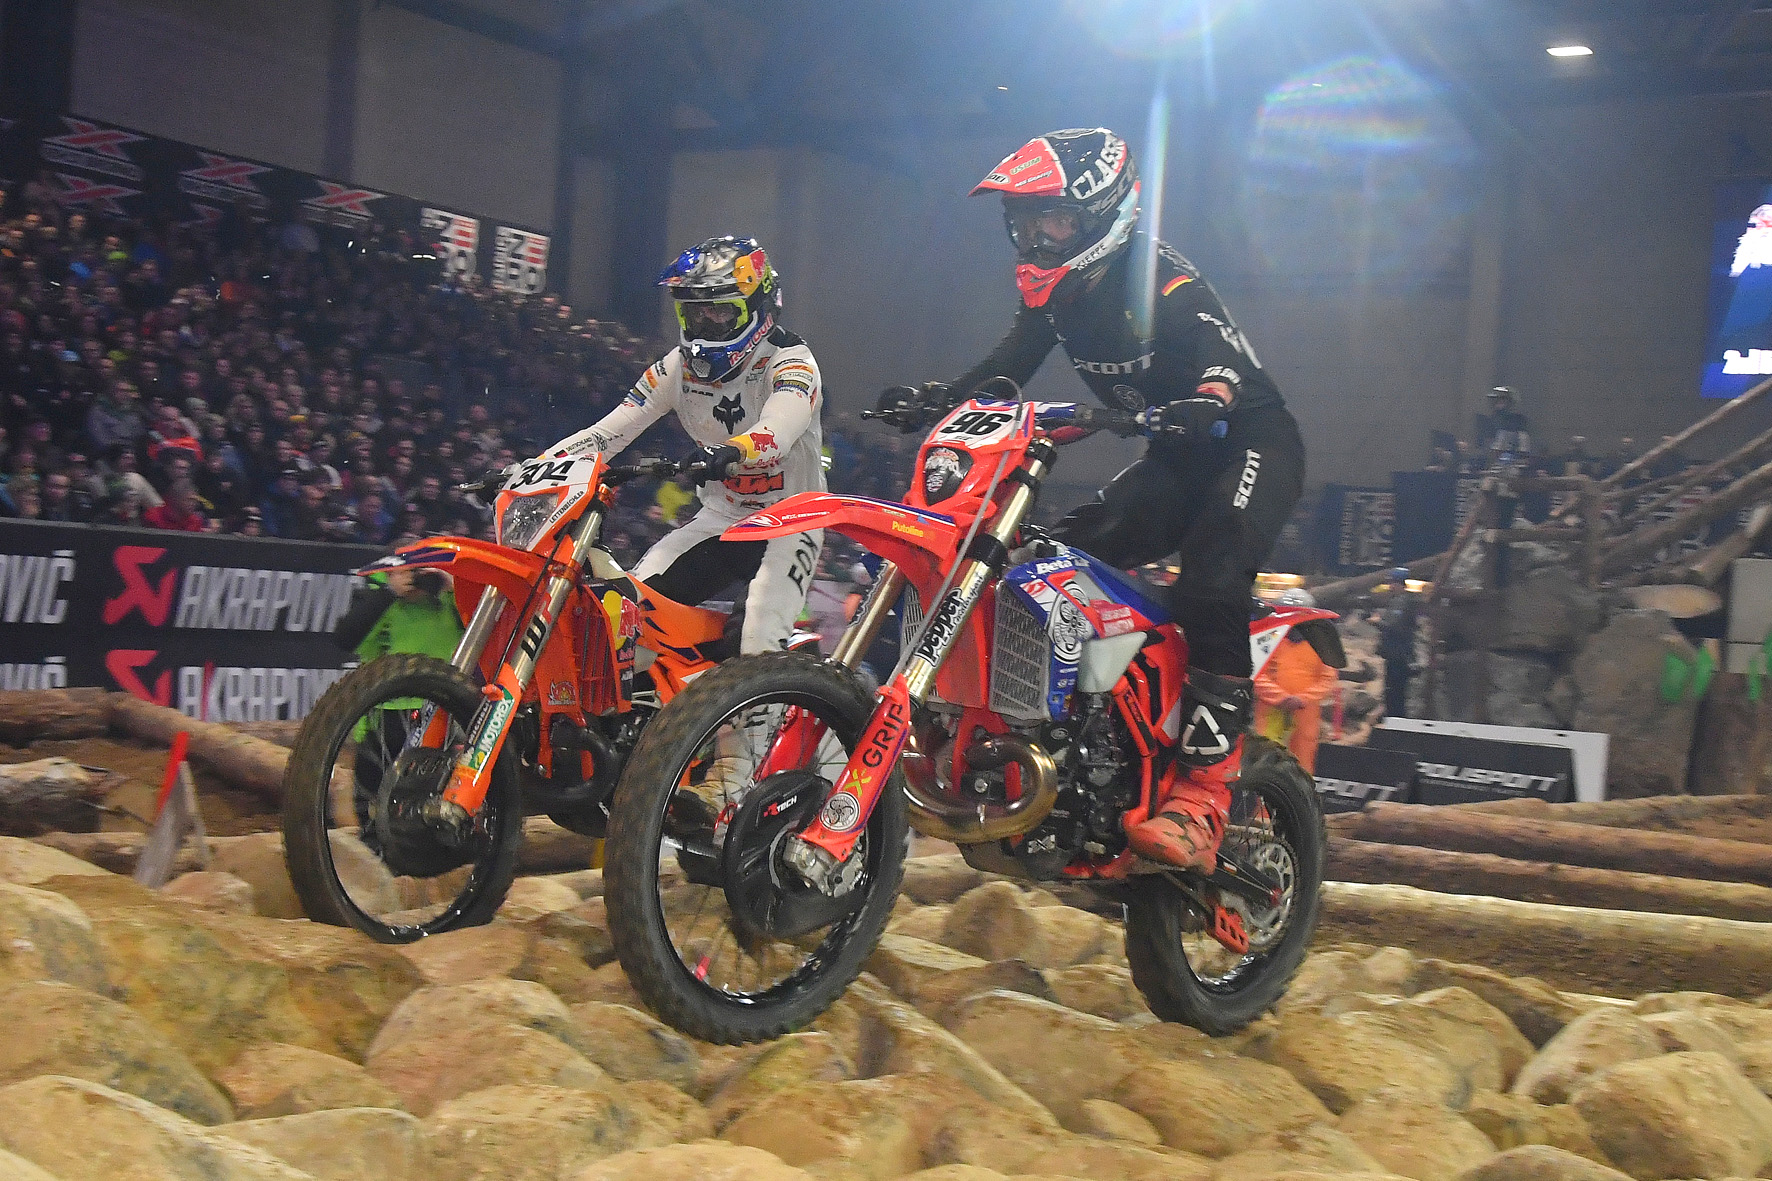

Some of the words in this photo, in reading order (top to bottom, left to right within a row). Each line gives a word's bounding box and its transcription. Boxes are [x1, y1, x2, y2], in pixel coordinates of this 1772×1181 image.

[939, 411, 1014, 436] 96
[1232, 448, 1262, 510] SCOTT
[892, 520, 925, 538] Putoline
[1036, 559, 1074, 575] Beta
